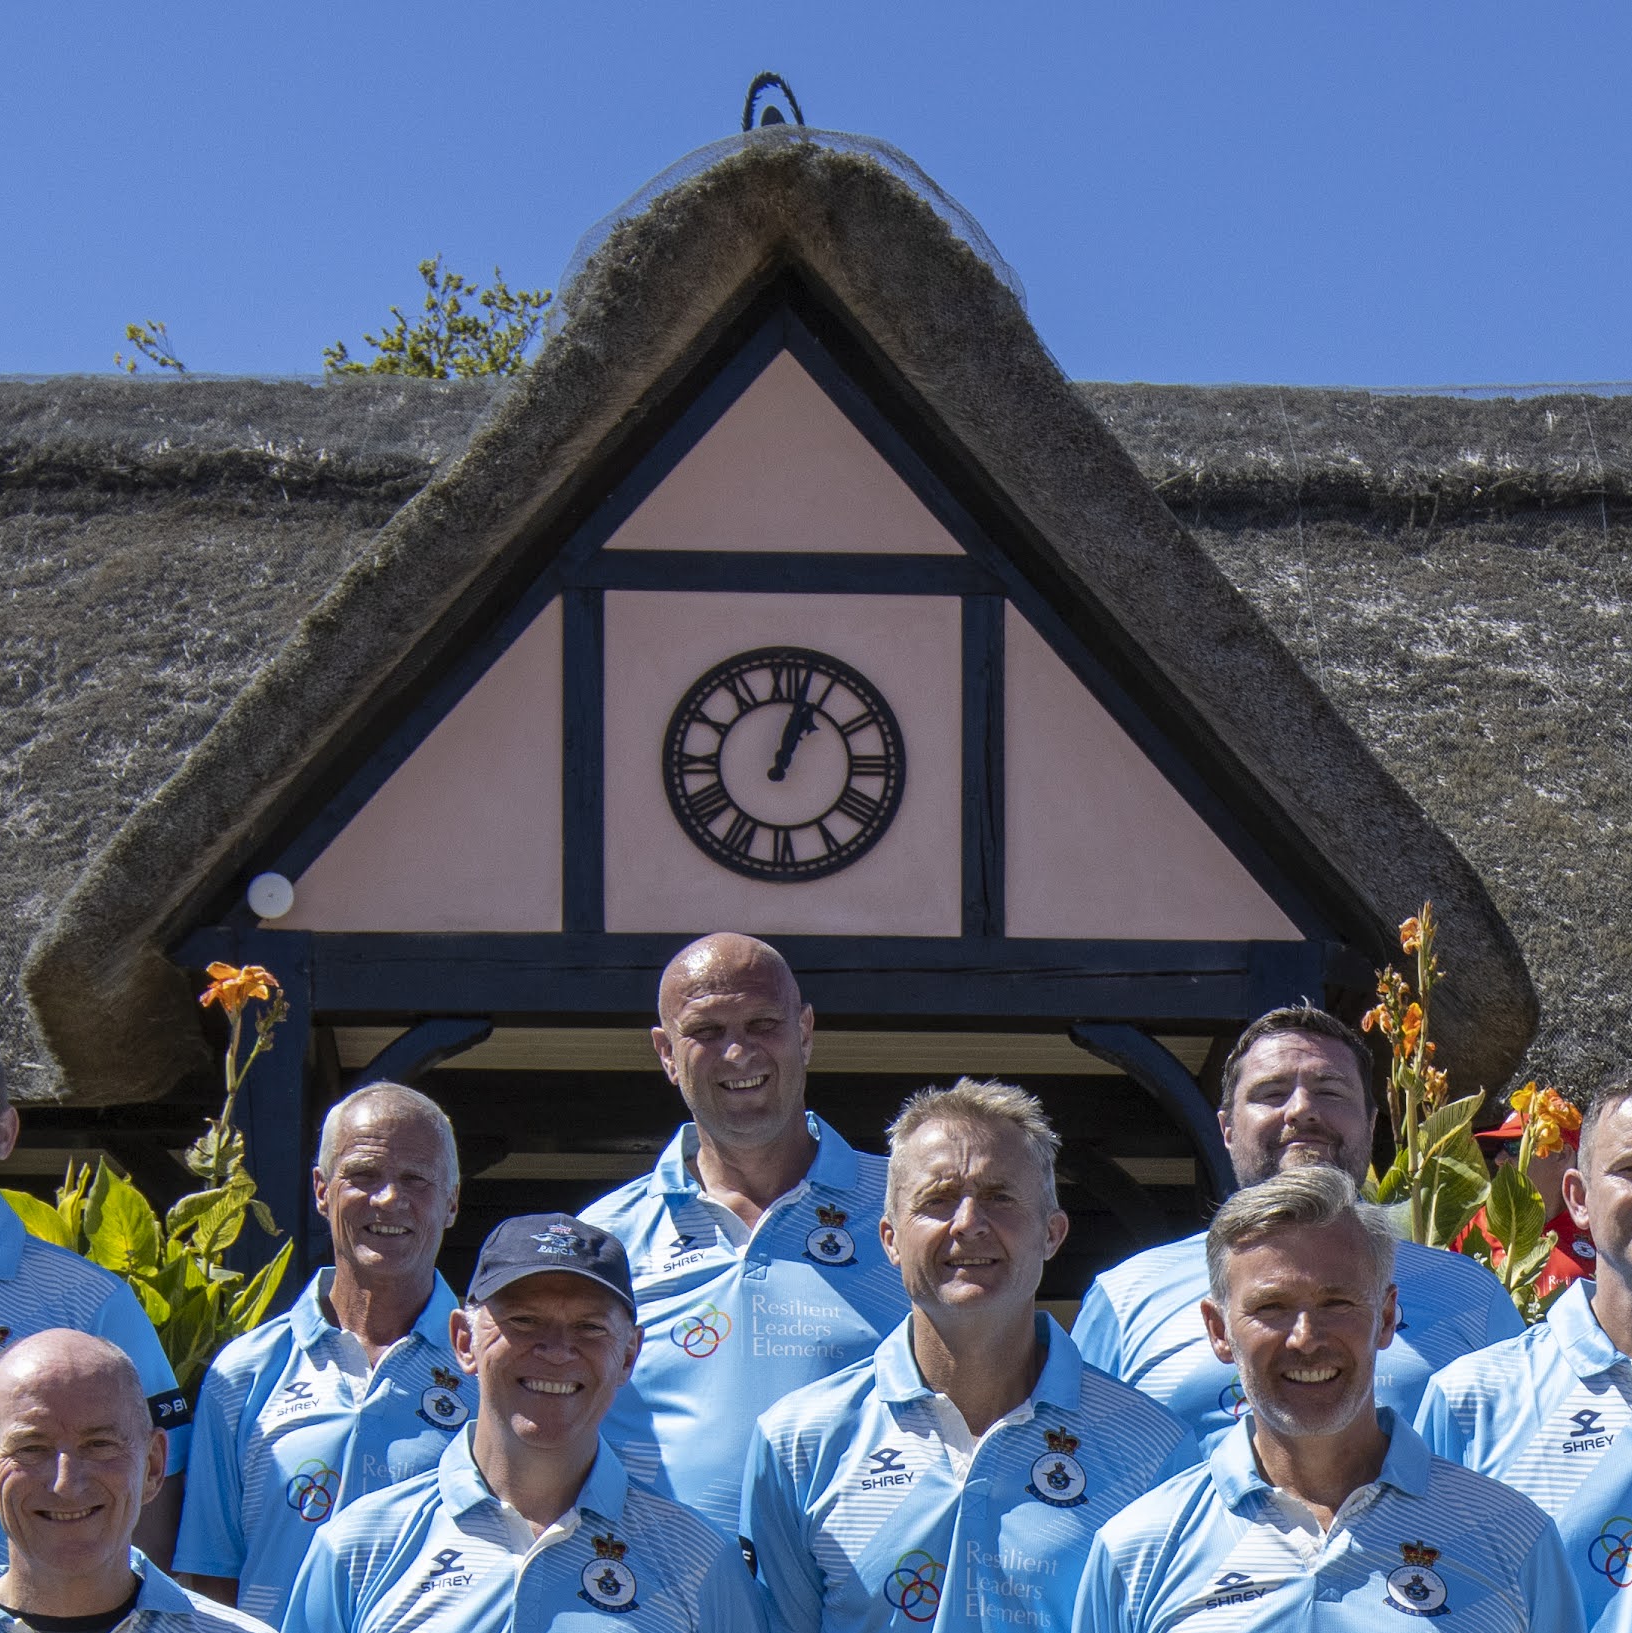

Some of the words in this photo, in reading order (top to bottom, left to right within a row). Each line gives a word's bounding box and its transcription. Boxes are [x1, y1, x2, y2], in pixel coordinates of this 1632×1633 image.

[663, 1252, 706, 1272] SHREY
[752, 1295, 839, 1318] Resilient
[753, 1316, 831, 1336] Leaders
[753, 1337, 844, 1358] Elements
[276, 1399, 320, 1416] SHREY
[1562, 1434, 1615, 1453] SHREY
[862, 1471, 914, 1490] SHREY
[967, 1540, 1056, 1576] Resilient
[421, 1574, 473, 1593] SHREY
[967, 1567, 1042, 1599] Leaders
[1206, 1587, 1267, 1610] SHREY
[966, 1595, 1051, 1628] Elements
